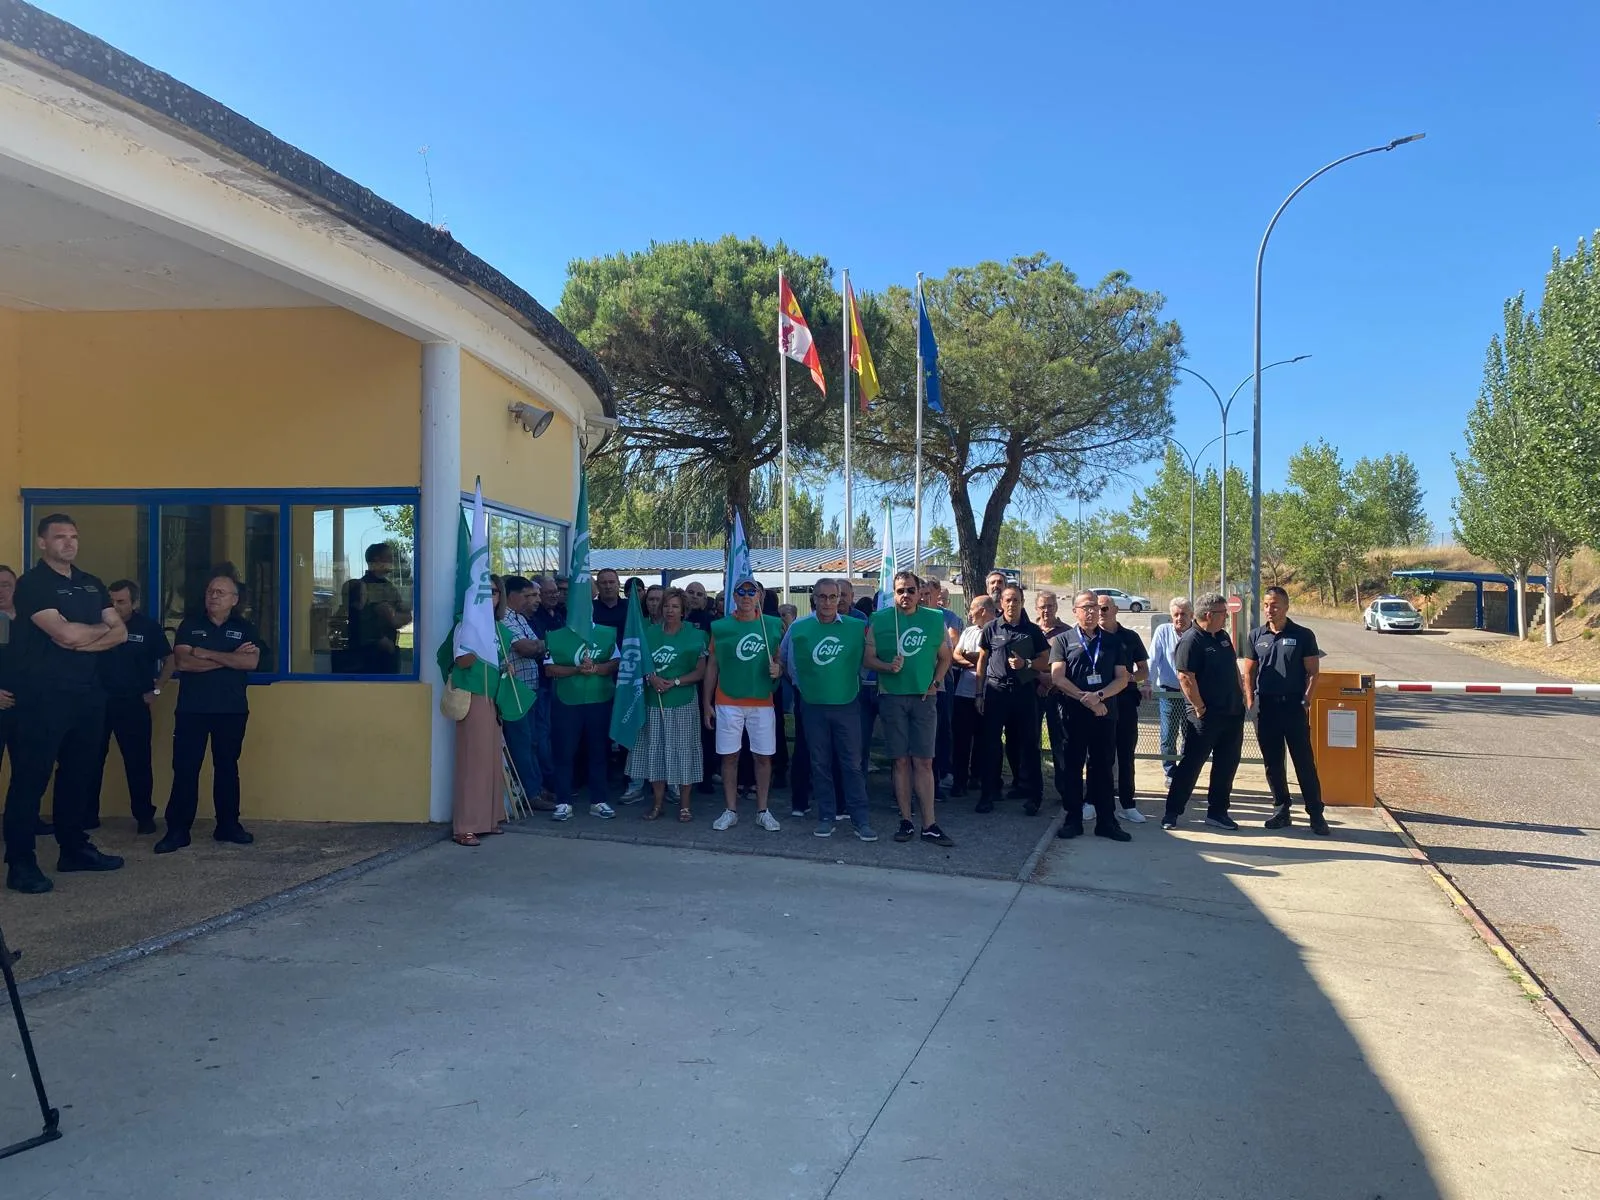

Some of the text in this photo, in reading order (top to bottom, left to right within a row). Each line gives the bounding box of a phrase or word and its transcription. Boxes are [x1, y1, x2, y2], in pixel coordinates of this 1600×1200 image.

[742, 640, 766, 653] CSIF
[904, 635, 928, 647] CSIF
[818, 644, 844, 656] CSIF
[653, 652, 678, 664] CSIF
